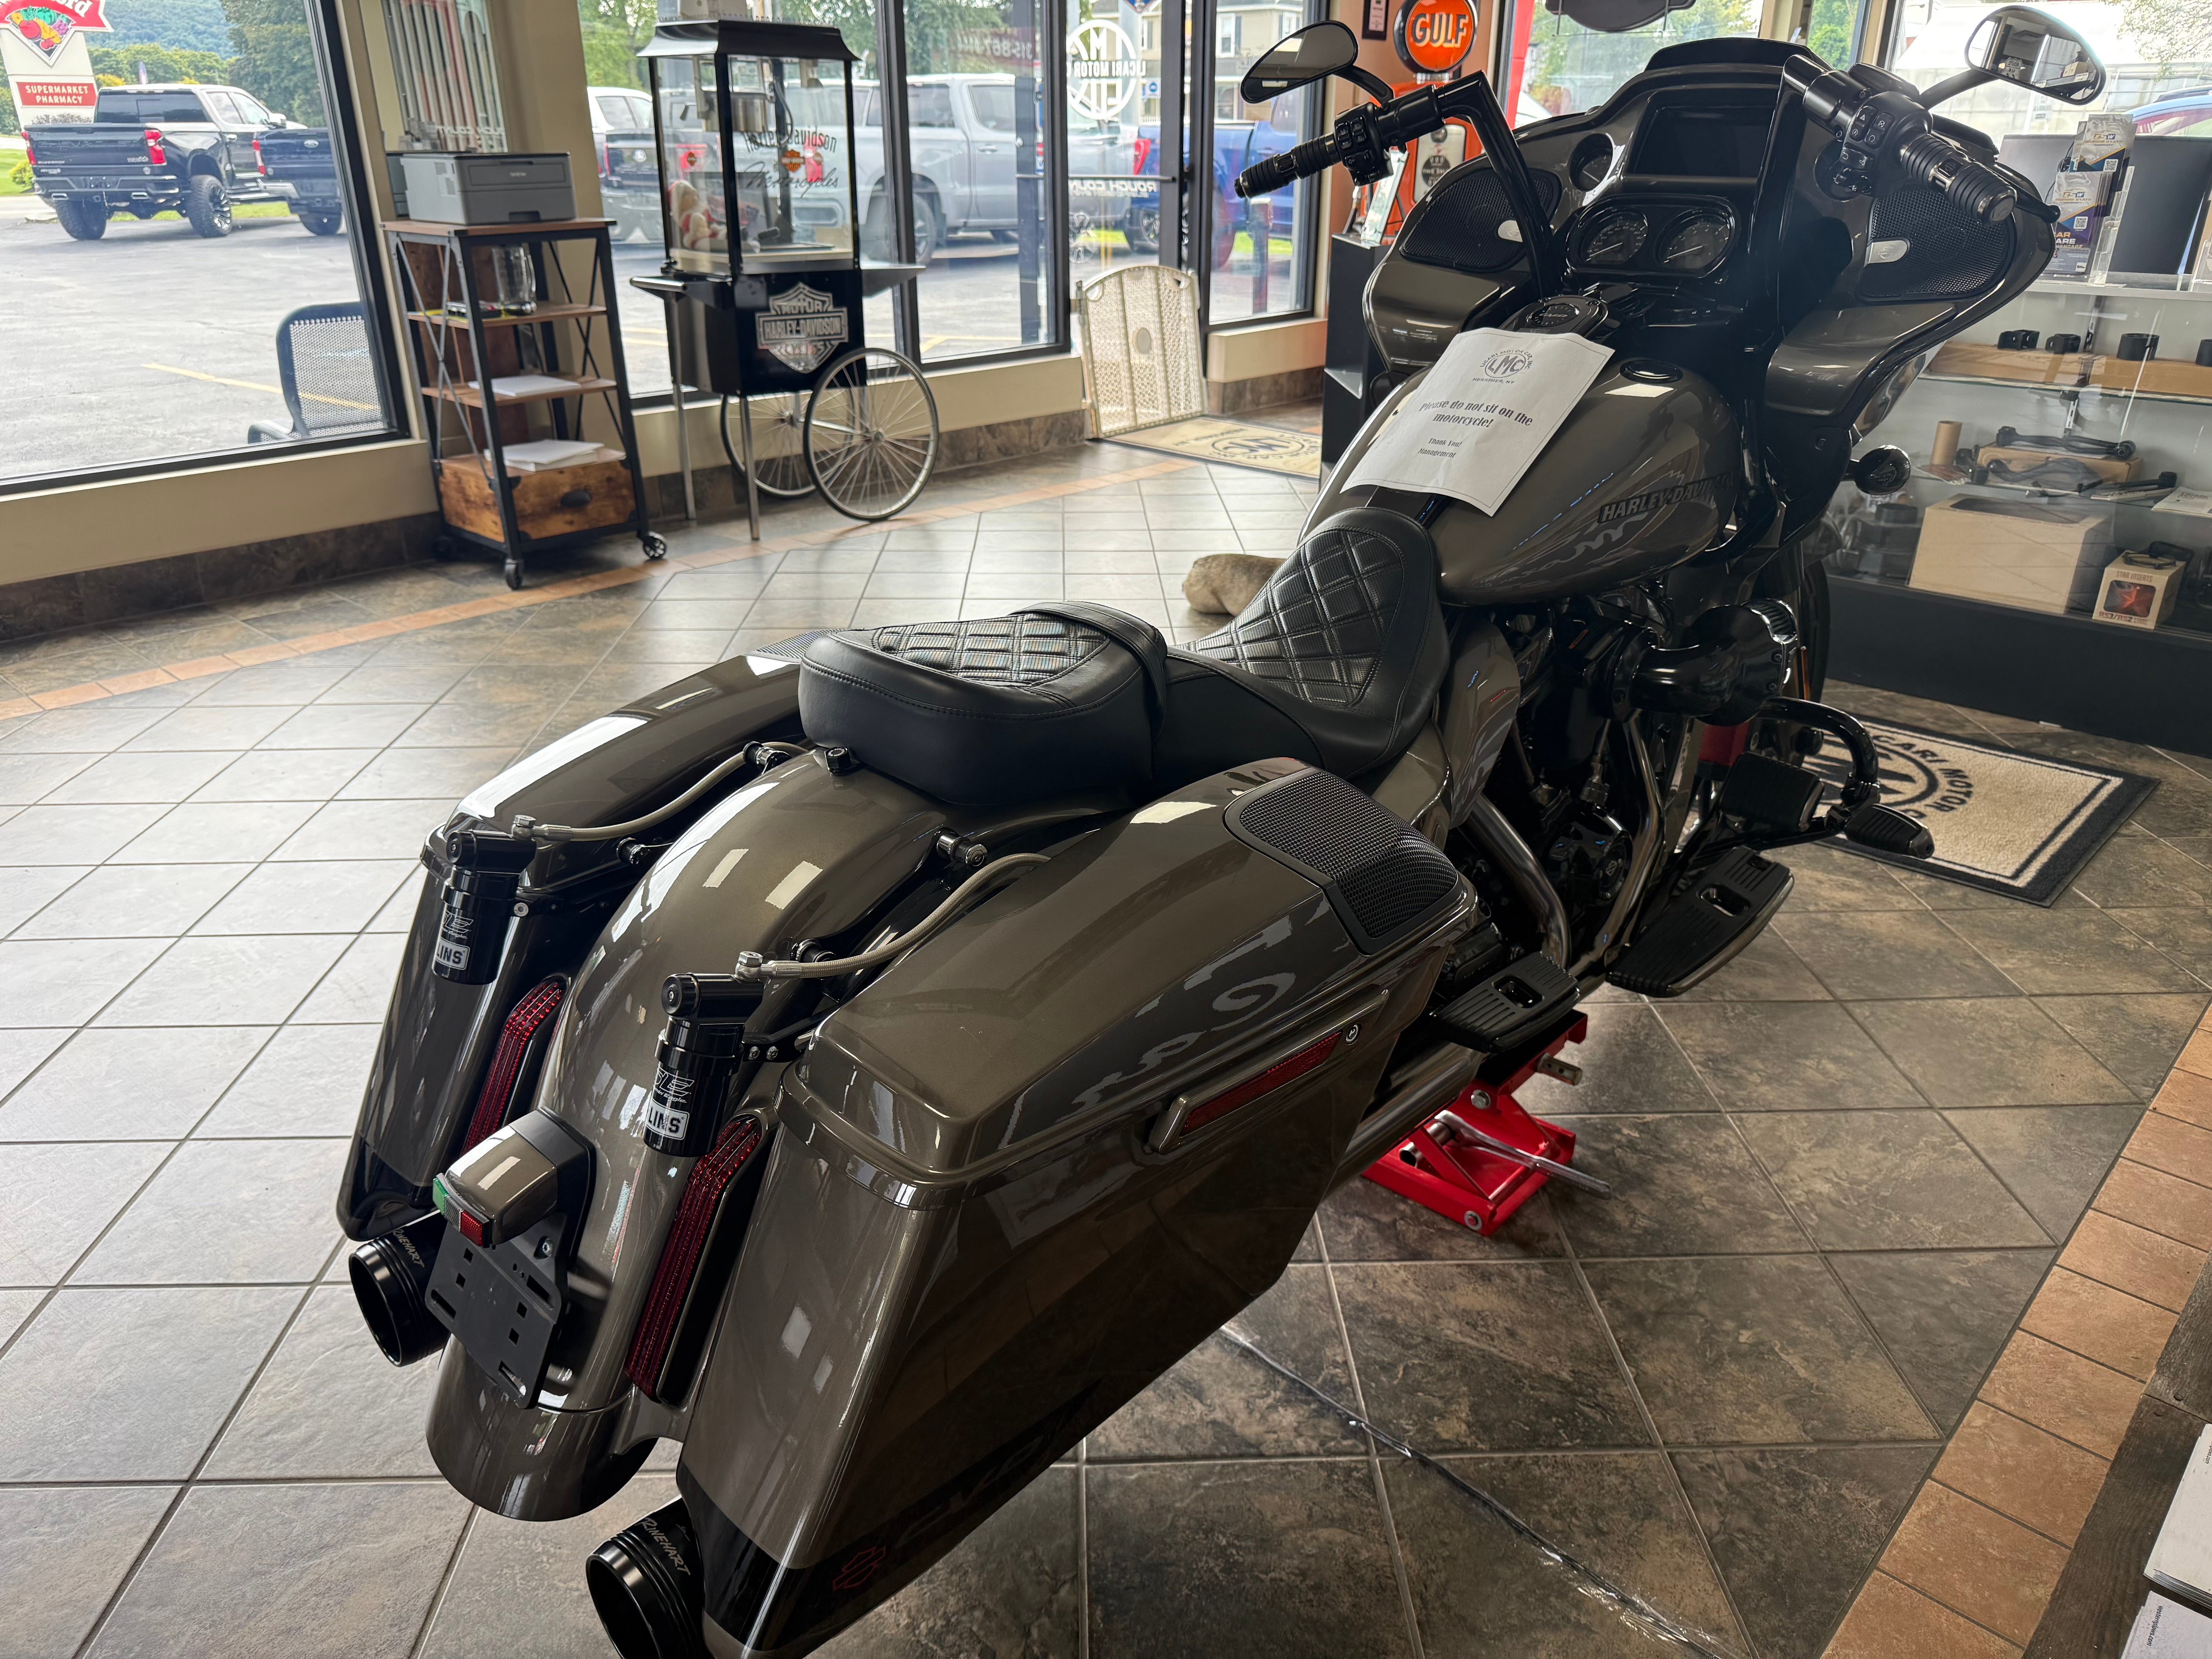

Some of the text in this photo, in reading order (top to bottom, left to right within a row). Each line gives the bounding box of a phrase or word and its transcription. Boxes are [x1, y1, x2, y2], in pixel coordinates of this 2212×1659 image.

[1412, 13, 1468, 48] GULF
[25, 85, 88, 94] SUPERMARKET
[36, 95, 82, 104] PHARMACY
[781, 300, 823, 313] MOTOR
[764, 316, 842, 340] HARLEY-DAVIDSON
[1480, 353, 1498, 368] LICARI
[1488, 356, 1524, 375] LMC
[1419, 400, 1532, 426] Please do not sit on the
[1433, 414, 1494, 427] motorcycle!
[1418, 448, 1456, 458] Management
[1602, 471, 1733, 522] HARLEY-DAVIDSON
[2131, 574, 2153, 582] INSERTS
[1925, 768, 1973, 812] MOTOR
[663, 1094, 687, 1103] Eagle
[393, 1229, 424, 1267] RINEHART
[642, 1518, 690, 1575] RINEHART
[2146, 1606, 2163, 1646] westernplows.com
